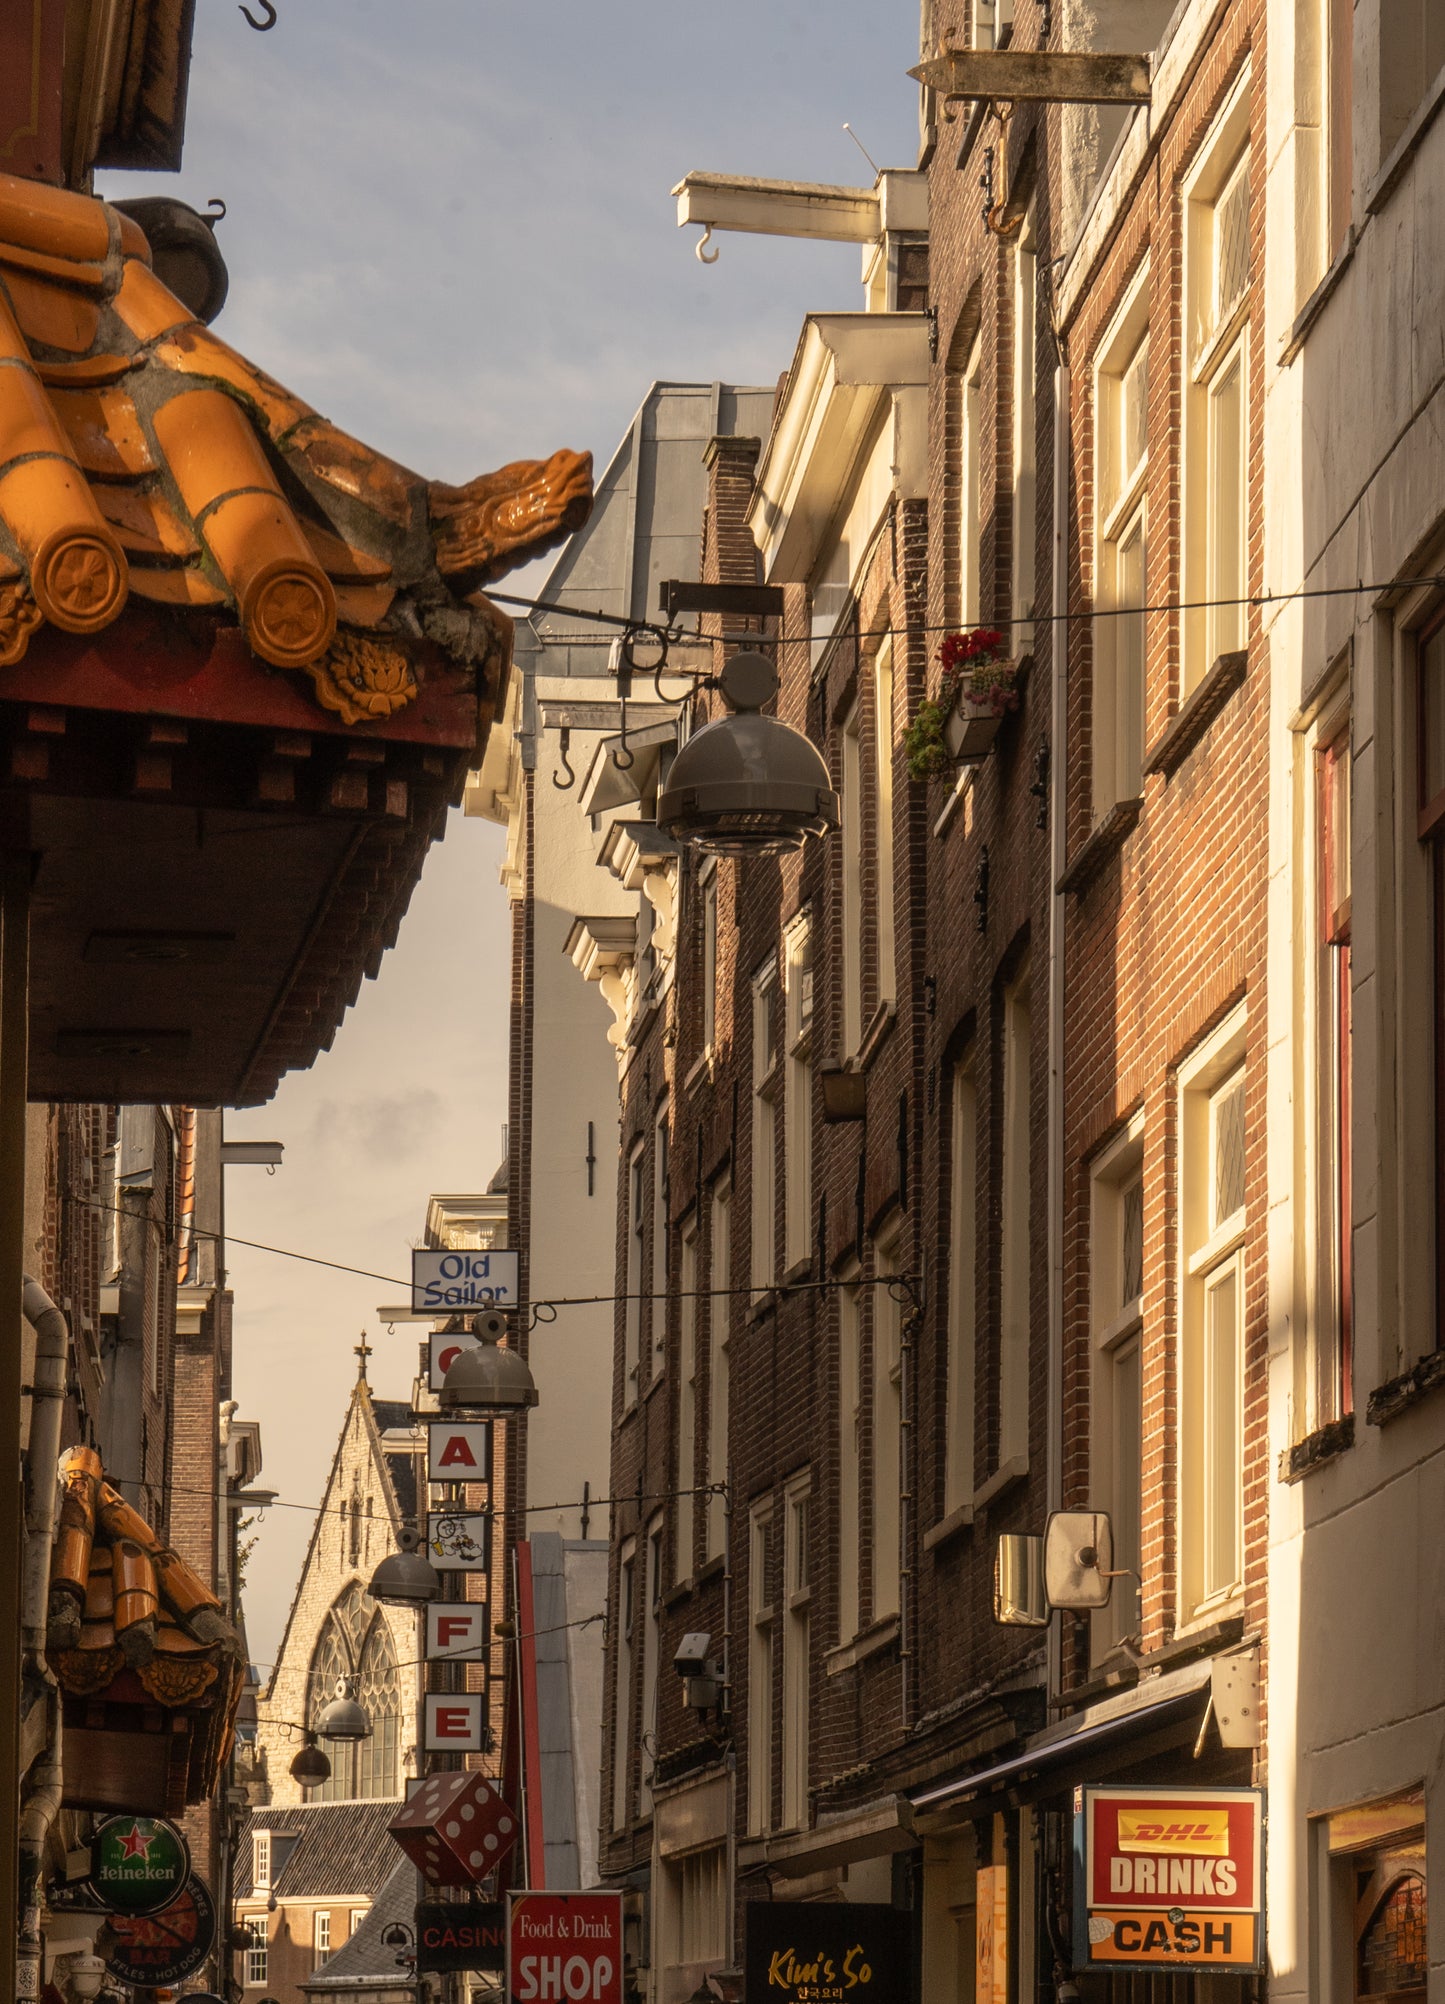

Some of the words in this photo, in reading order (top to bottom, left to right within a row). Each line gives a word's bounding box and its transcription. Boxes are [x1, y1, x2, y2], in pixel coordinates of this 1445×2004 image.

[439, 1254, 490, 1280] Old
[423, 1280, 508, 1306] Sailor
[1134, 1824, 1215, 1841] DHL
[1110, 1857, 1237, 1896] DRINKS
[520, 1914, 554, 1938] Food
[557, 1916, 570, 1938] &
[573, 1914, 612, 1938] Drink
[1113, 1920, 1232, 1955] CASH
[110, 1957, 145, 1980] FFLES
[155, 1965, 179, 1981] HOT
[179, 1946, 201, 1971] DOG
[519, 1955, 613, 2000] SHOP
[768, 1947, 836, 1990] Kim's
[843, 1943, 872, 1989] So
[797, 1986, 844, 2000] 한국요리
